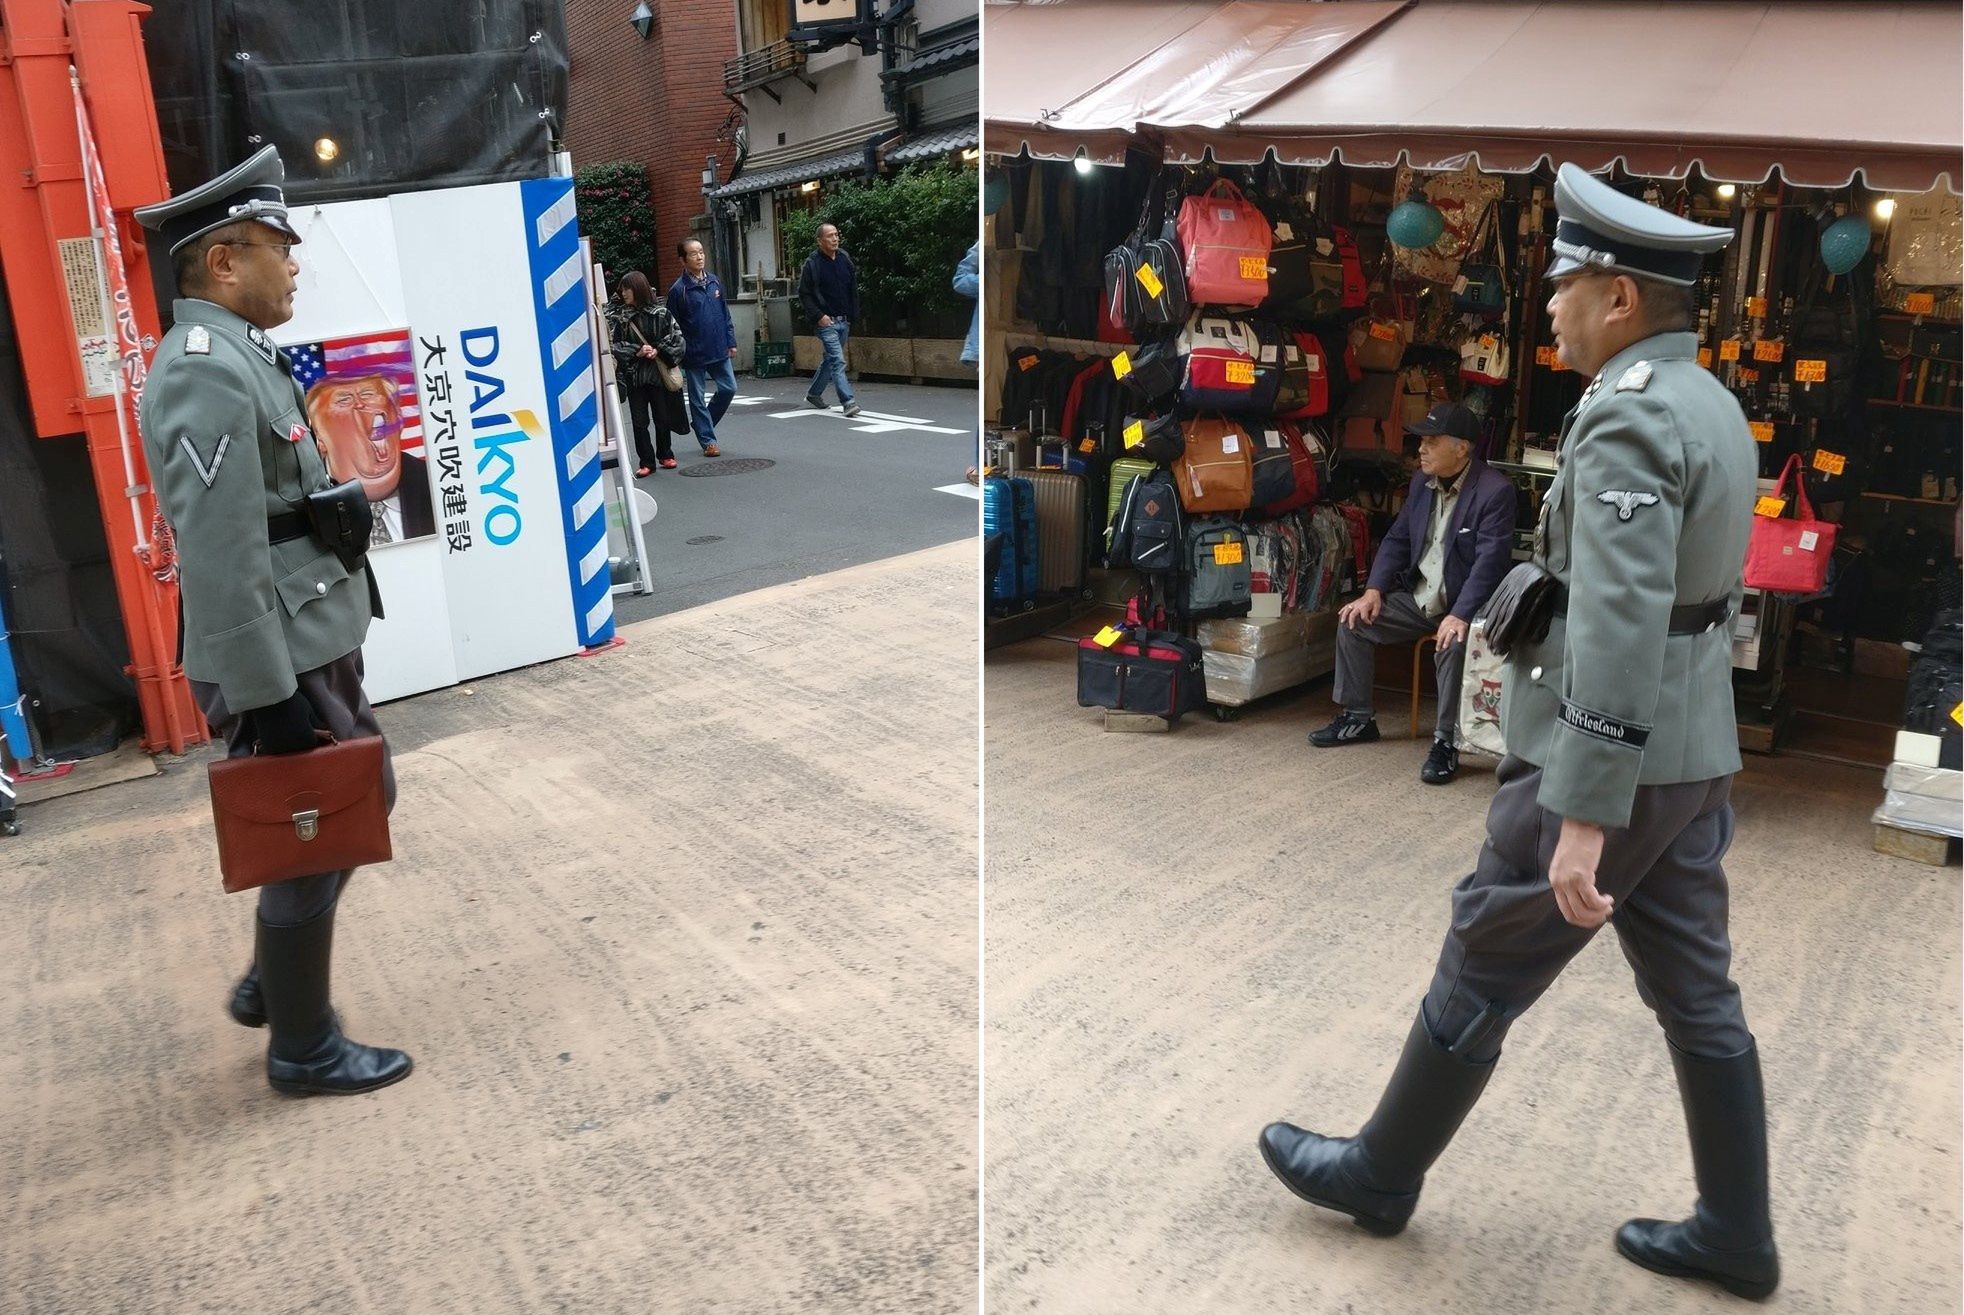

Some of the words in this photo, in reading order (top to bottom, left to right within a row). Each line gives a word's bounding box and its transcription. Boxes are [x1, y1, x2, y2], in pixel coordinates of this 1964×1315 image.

[419, 335, 473, 555] 大京穴吹建設
[460, 326, 530, 546] DAIKYO
